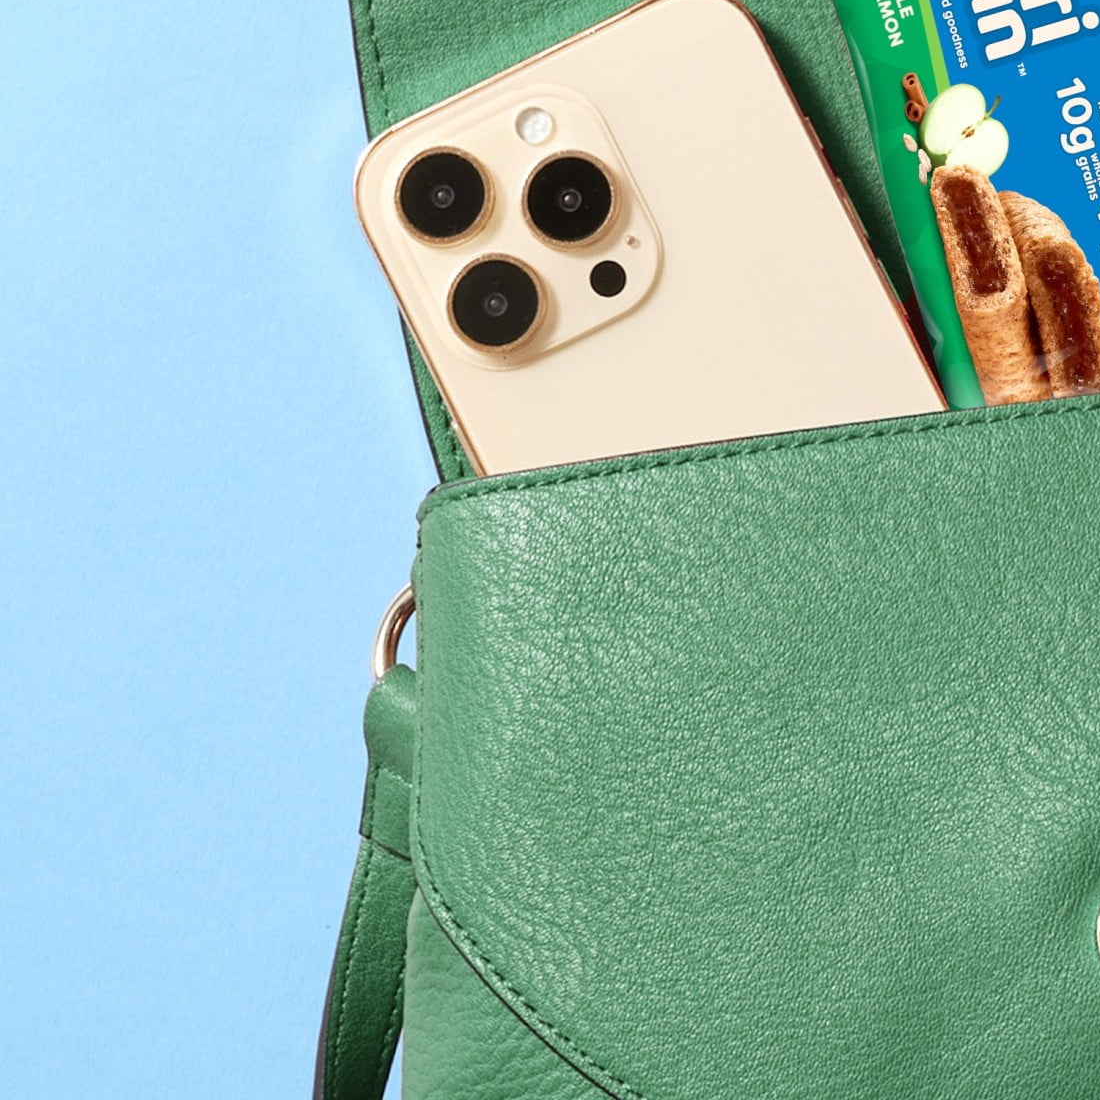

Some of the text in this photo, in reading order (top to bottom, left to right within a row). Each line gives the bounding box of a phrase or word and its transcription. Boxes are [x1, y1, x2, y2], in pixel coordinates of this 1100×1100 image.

[942, 10, 968, 69] goodness
[1056, 77, 1095, 154] 10g
[1075, 156, 1098, 201] grains
